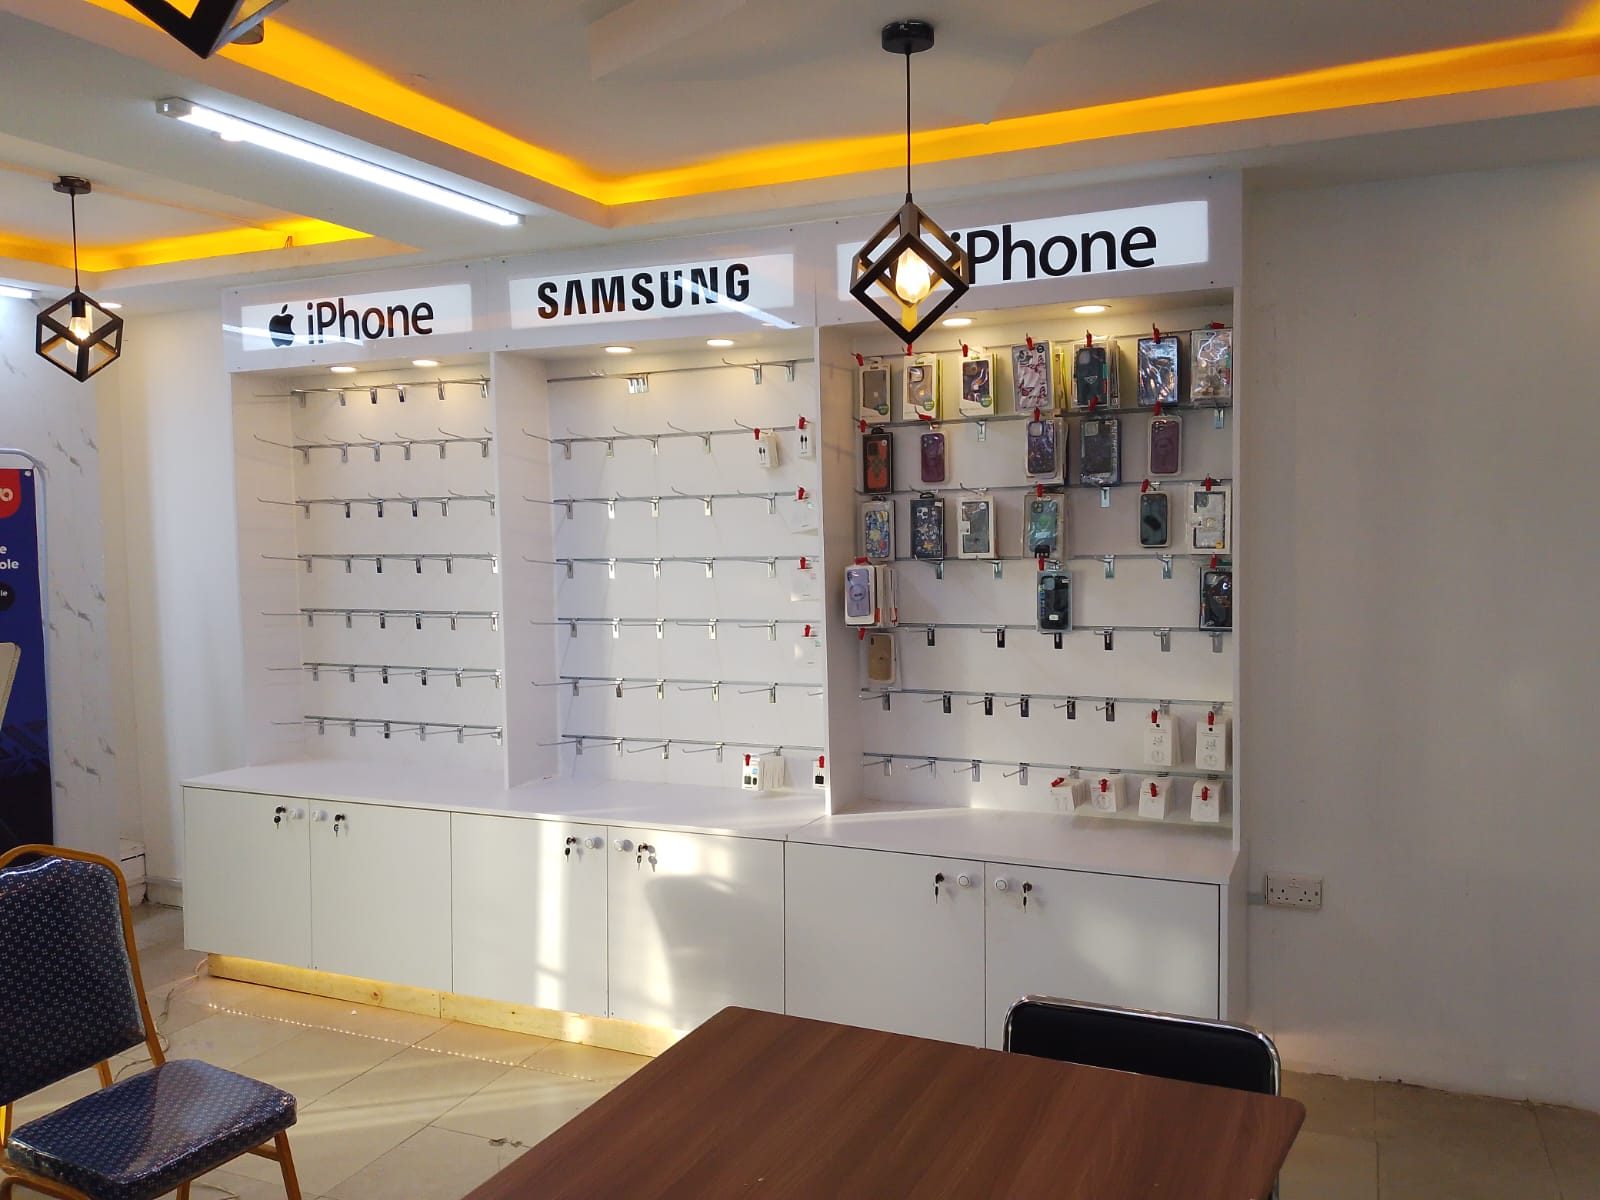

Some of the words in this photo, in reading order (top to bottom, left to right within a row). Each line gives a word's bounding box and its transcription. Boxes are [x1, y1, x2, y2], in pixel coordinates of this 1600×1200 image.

[951, 224, 1157, 285] Phone
[537, 263, 750, 320] SAMSUNG
[306, 298, 434, 344] iPhone
